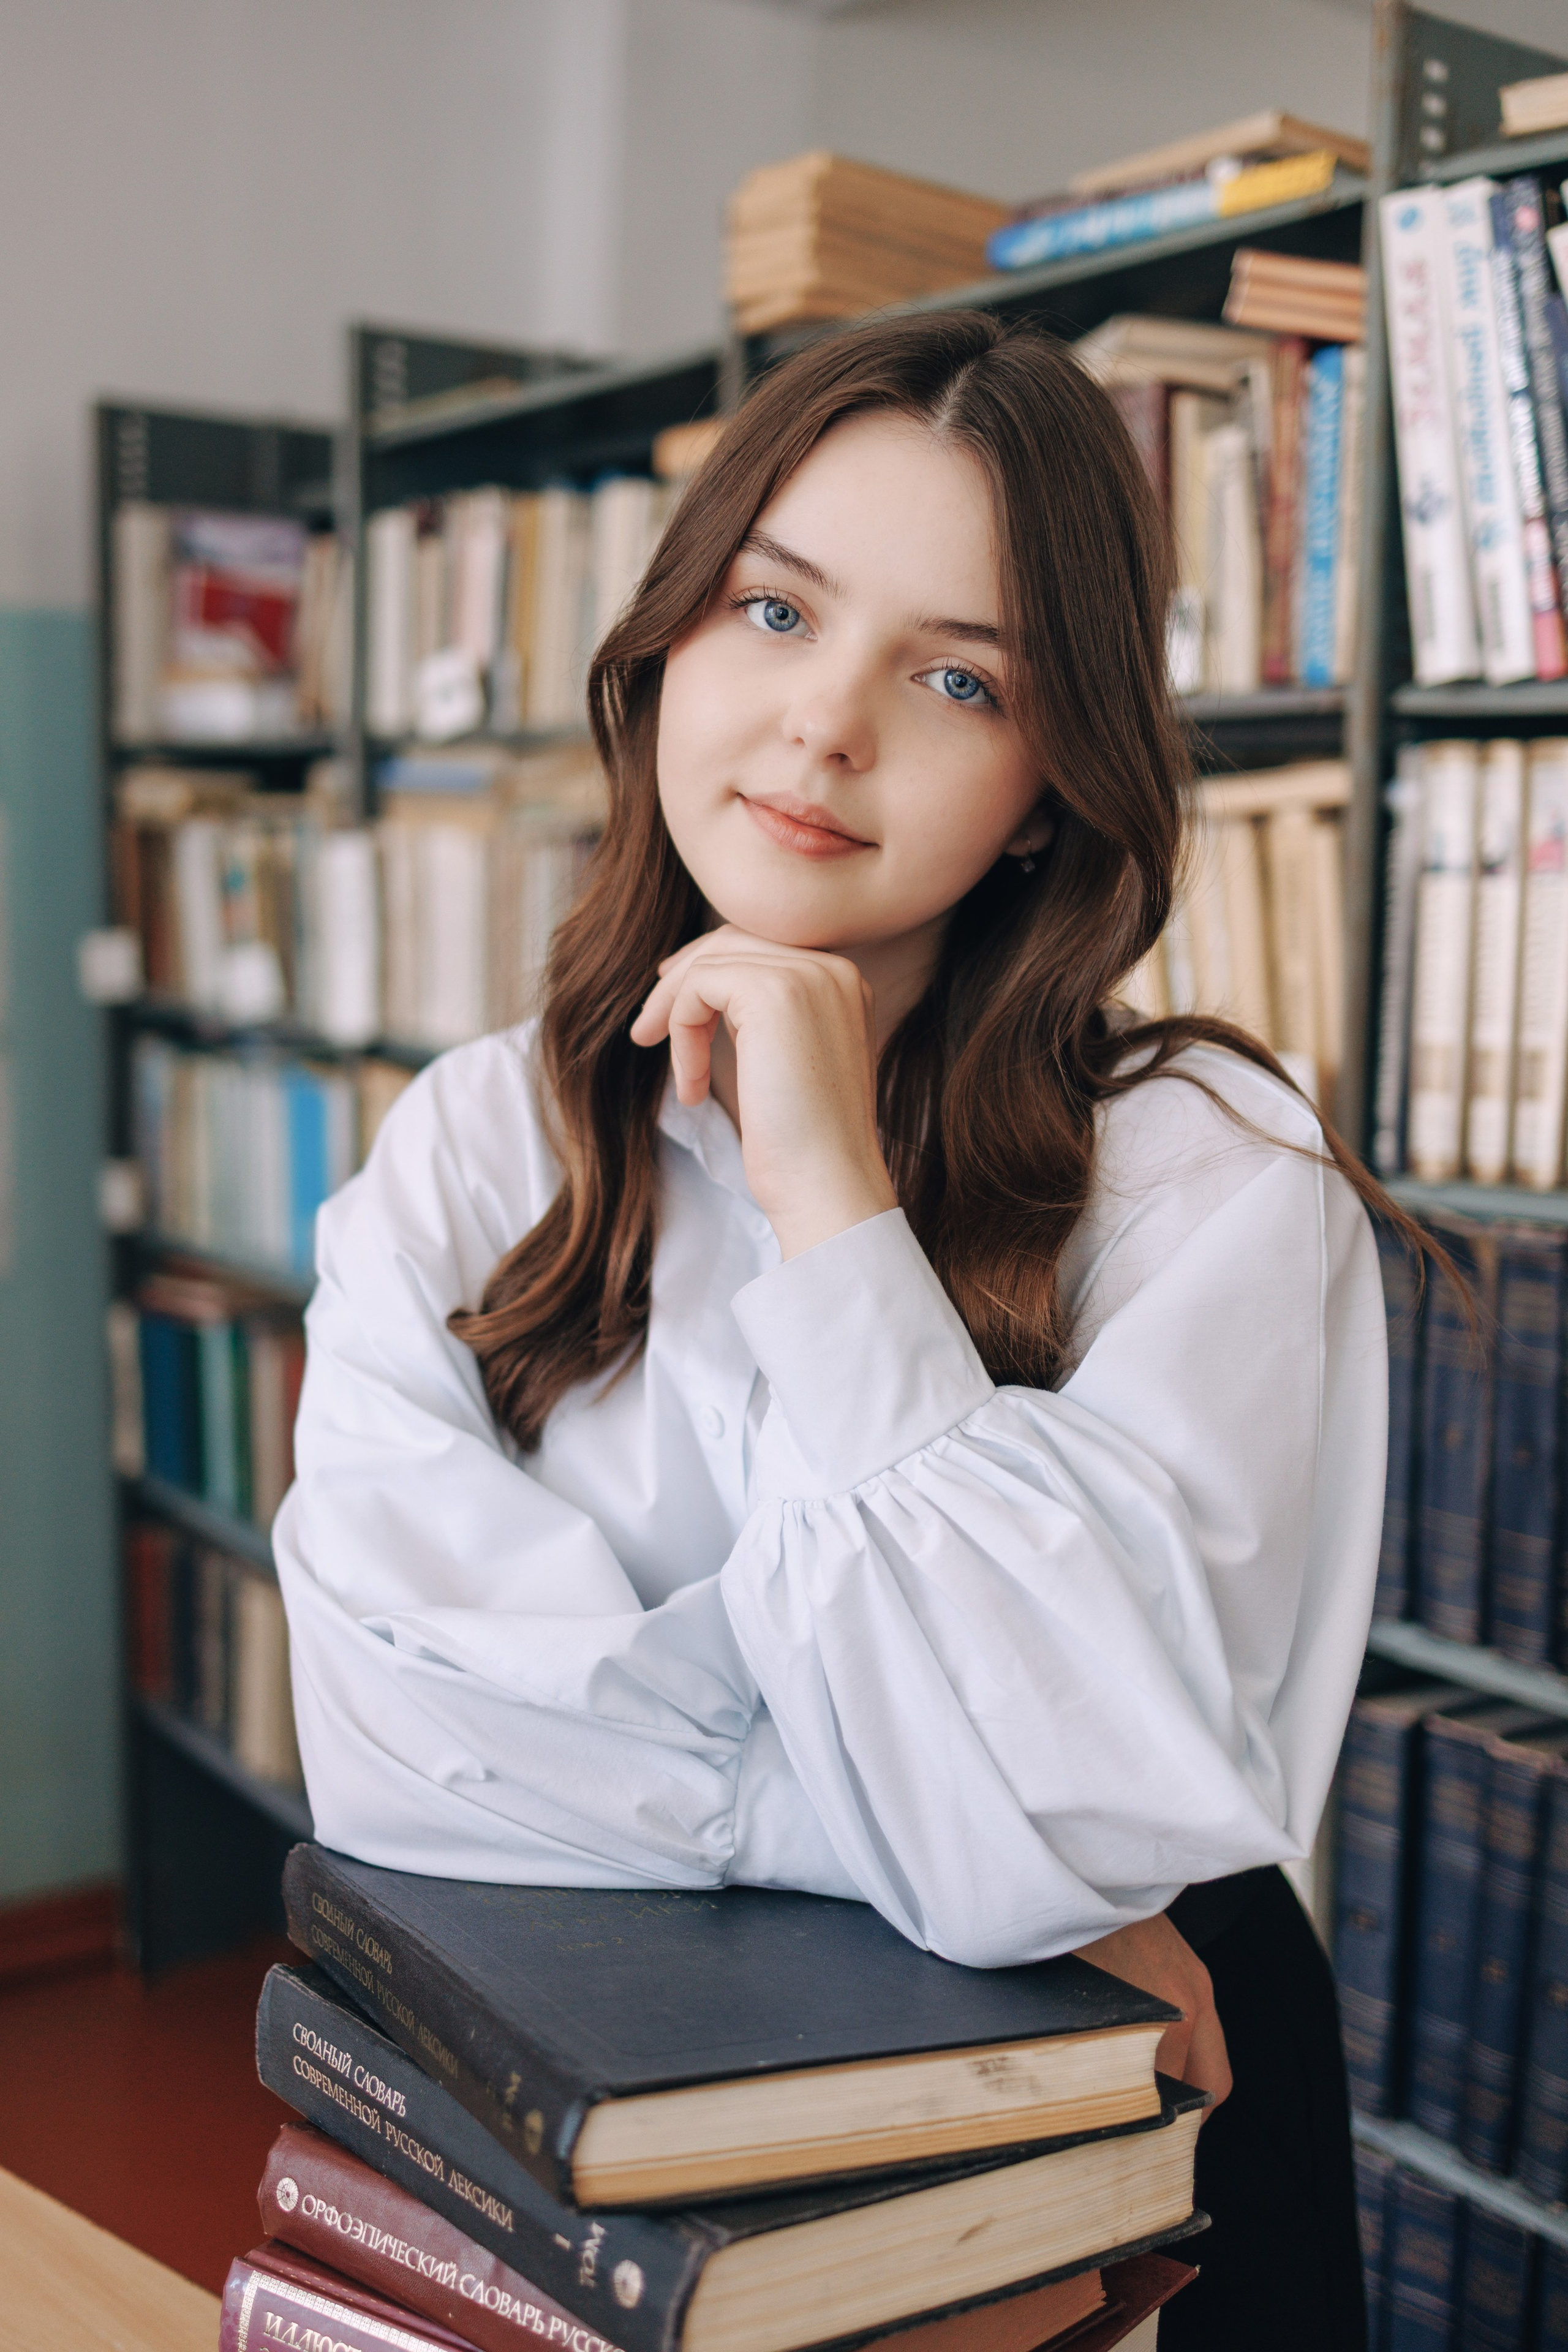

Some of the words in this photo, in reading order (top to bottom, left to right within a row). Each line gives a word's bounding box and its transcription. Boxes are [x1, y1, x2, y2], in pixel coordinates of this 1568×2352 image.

[311, 1924, 374, 1994] СОВРЕМЕННОЙ
[377, 1980, 415, 2035] РУССКОЙ
[418, 2023, 458, 2078] ЛЕКСИКИ
[312, 1892, 355, 1940] СВОДНЫЙ
[356, 1928, 393, 1974] СЛОВАРЬ
[293, 2022, 352, 2078] СВОДНЫЙ
[354, 2066, 406, 2117] СЛОВАРЬ
[293, 2056, 381, 2134] СОВРЕМЕННОЙ
[385, 2120, 444, 2182] РУССКОЙ
[448, 2169, 514, 2233] ЛЕКСИКИ
[302, 2194, 459, 2289] ОРФОЭПИЧЕСКИЙ
[459, 2273, 545, 2335] СЛОВАРЬ
